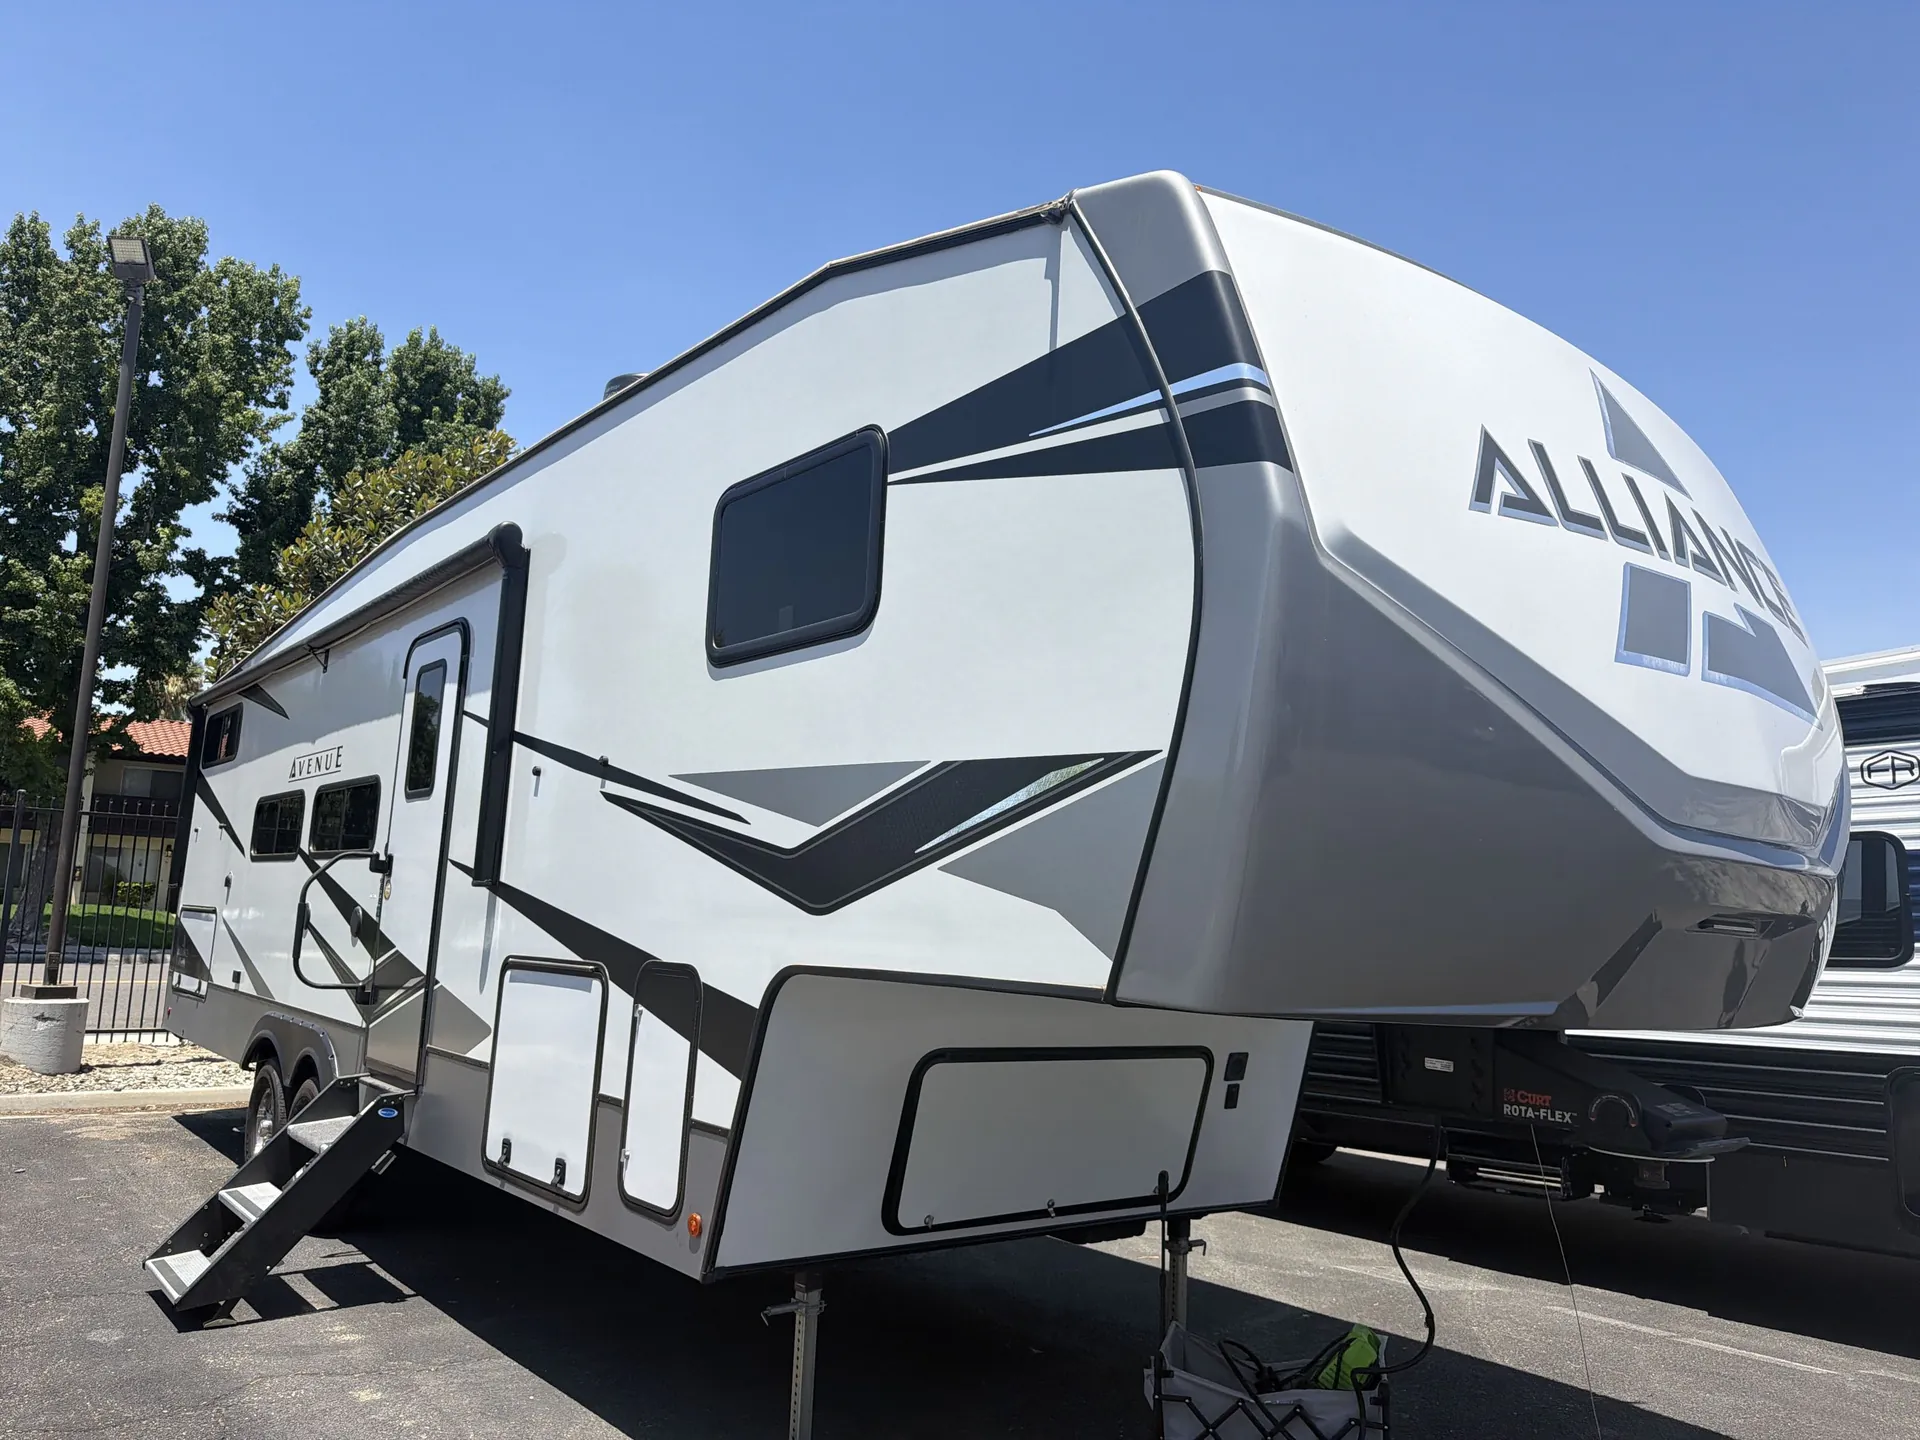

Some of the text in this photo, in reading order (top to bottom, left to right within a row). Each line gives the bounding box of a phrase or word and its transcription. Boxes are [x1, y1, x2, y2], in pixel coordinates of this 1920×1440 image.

[1469, 424, 1809, 648] ALLIANCE
[289, 745, 343, 779] AVENUE
[1517, 1091, 1551, 1106] CURT
